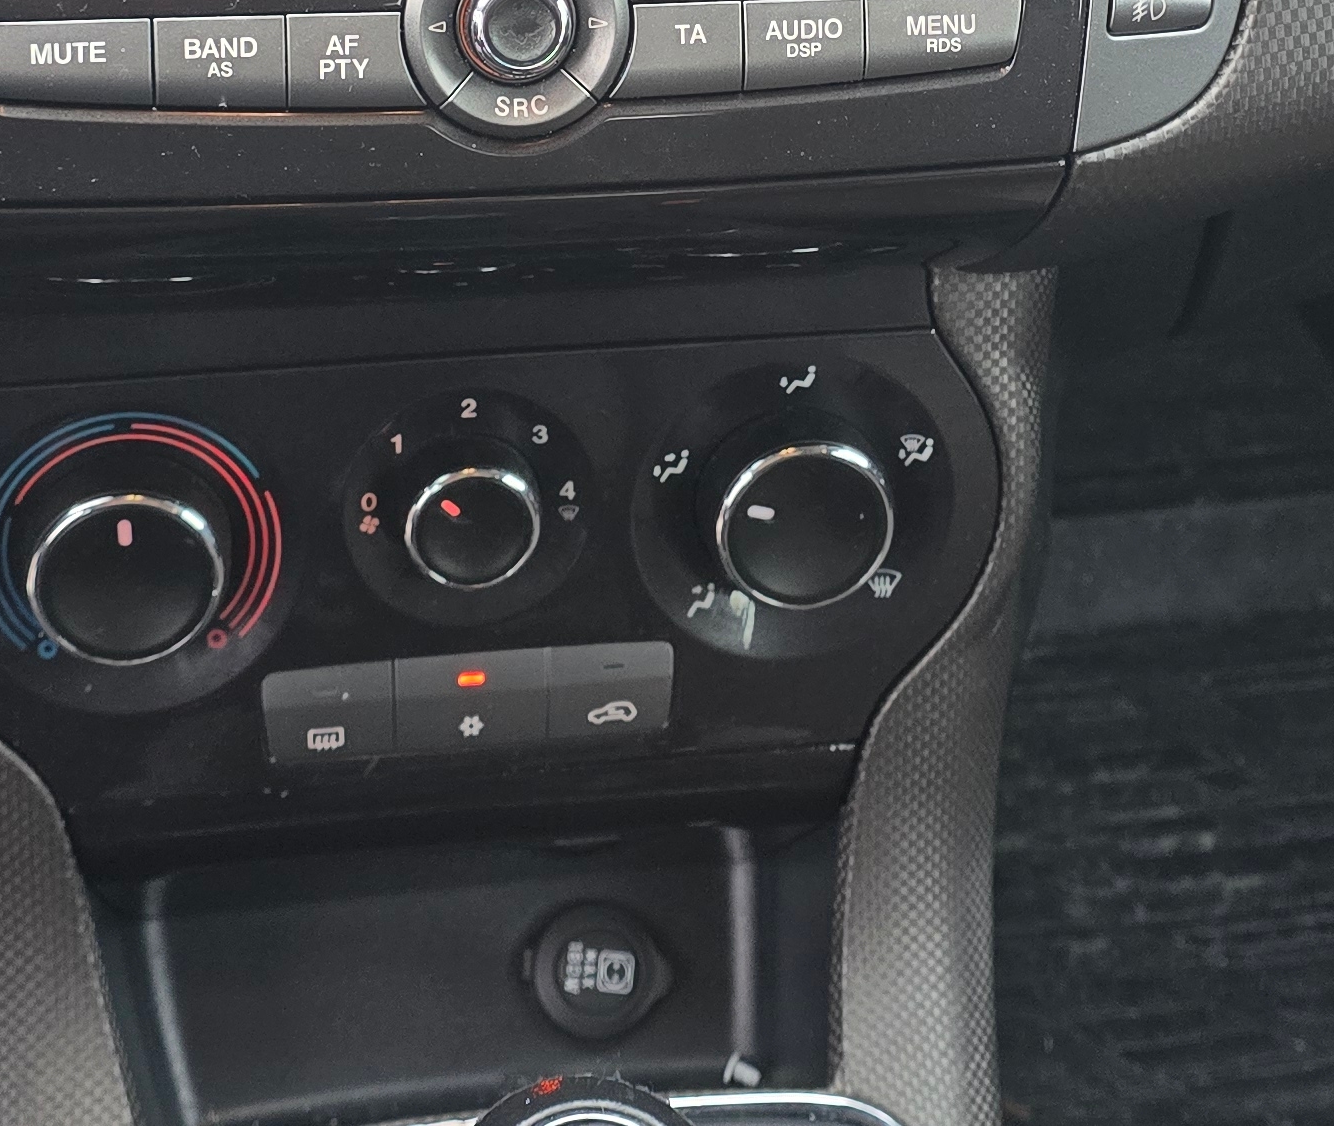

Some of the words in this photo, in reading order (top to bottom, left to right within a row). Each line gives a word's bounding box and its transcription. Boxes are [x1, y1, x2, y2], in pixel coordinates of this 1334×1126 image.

[674, 23, 707, 45] TA
[765, 17, 843, 41] AUDIO
[906, 13, 976, 36] MENU
[29, 41, 107, 65] MUTE
[183, 36, 258, 60] BAND
[325, 34, 360, 56] AF
[786, 41, 822, 58] DSP
[926, 36, 962, 53] RDS
[207, 61, 234, 78] AS
[319, 57, 370, 80] PTY
[494, 94, 550, 118] SRC
[460, 397, 478, 419] 2
[390, 433, 403, 454] 1
[531, 424, 549, 444] 3
[559, 480, 576, 501] 4
[360, 492, 378, 512] 0
